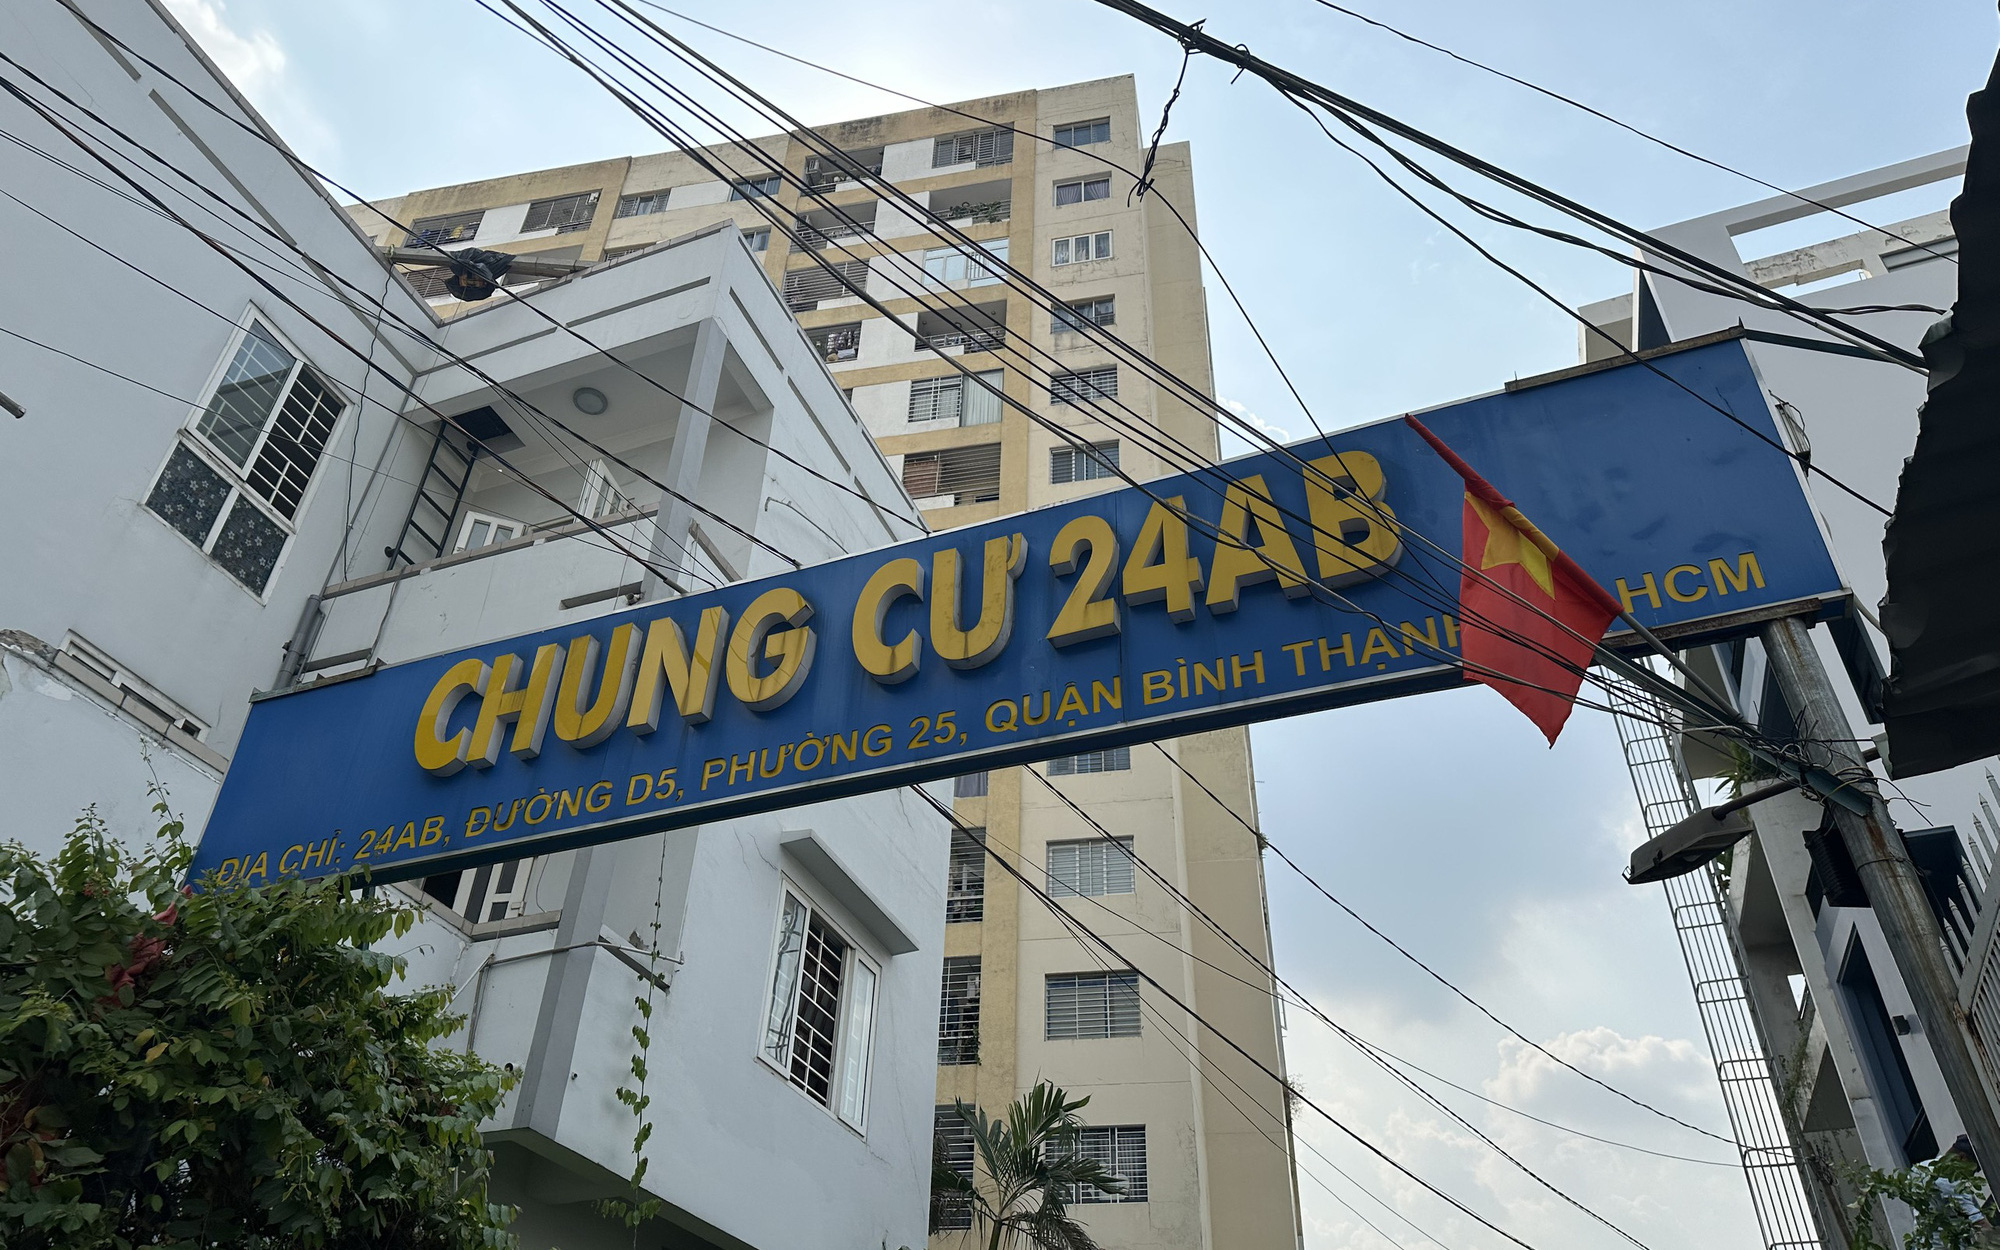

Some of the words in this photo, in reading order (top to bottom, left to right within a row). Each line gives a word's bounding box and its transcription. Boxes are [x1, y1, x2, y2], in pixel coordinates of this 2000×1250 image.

[278, 828, 347, 875] CHỈ:
[352, 814, 452, 861] 24AB,
[464, 778, 614, 839] ĐƯỜNG
[624, 767, 686, 806] D5,
[700, 723, 893, 791] PHƯỜNG
[907, 710, 968, 750] 25,
[1142, 648, 1266, 706] BÌNH
[1615, 551, 1766, 614] HCM
[414, 586, 817, 777] CHUNG
[851, 533, 1028, 686] CƯ
[1046, 449, 1404, 649] 24AB
